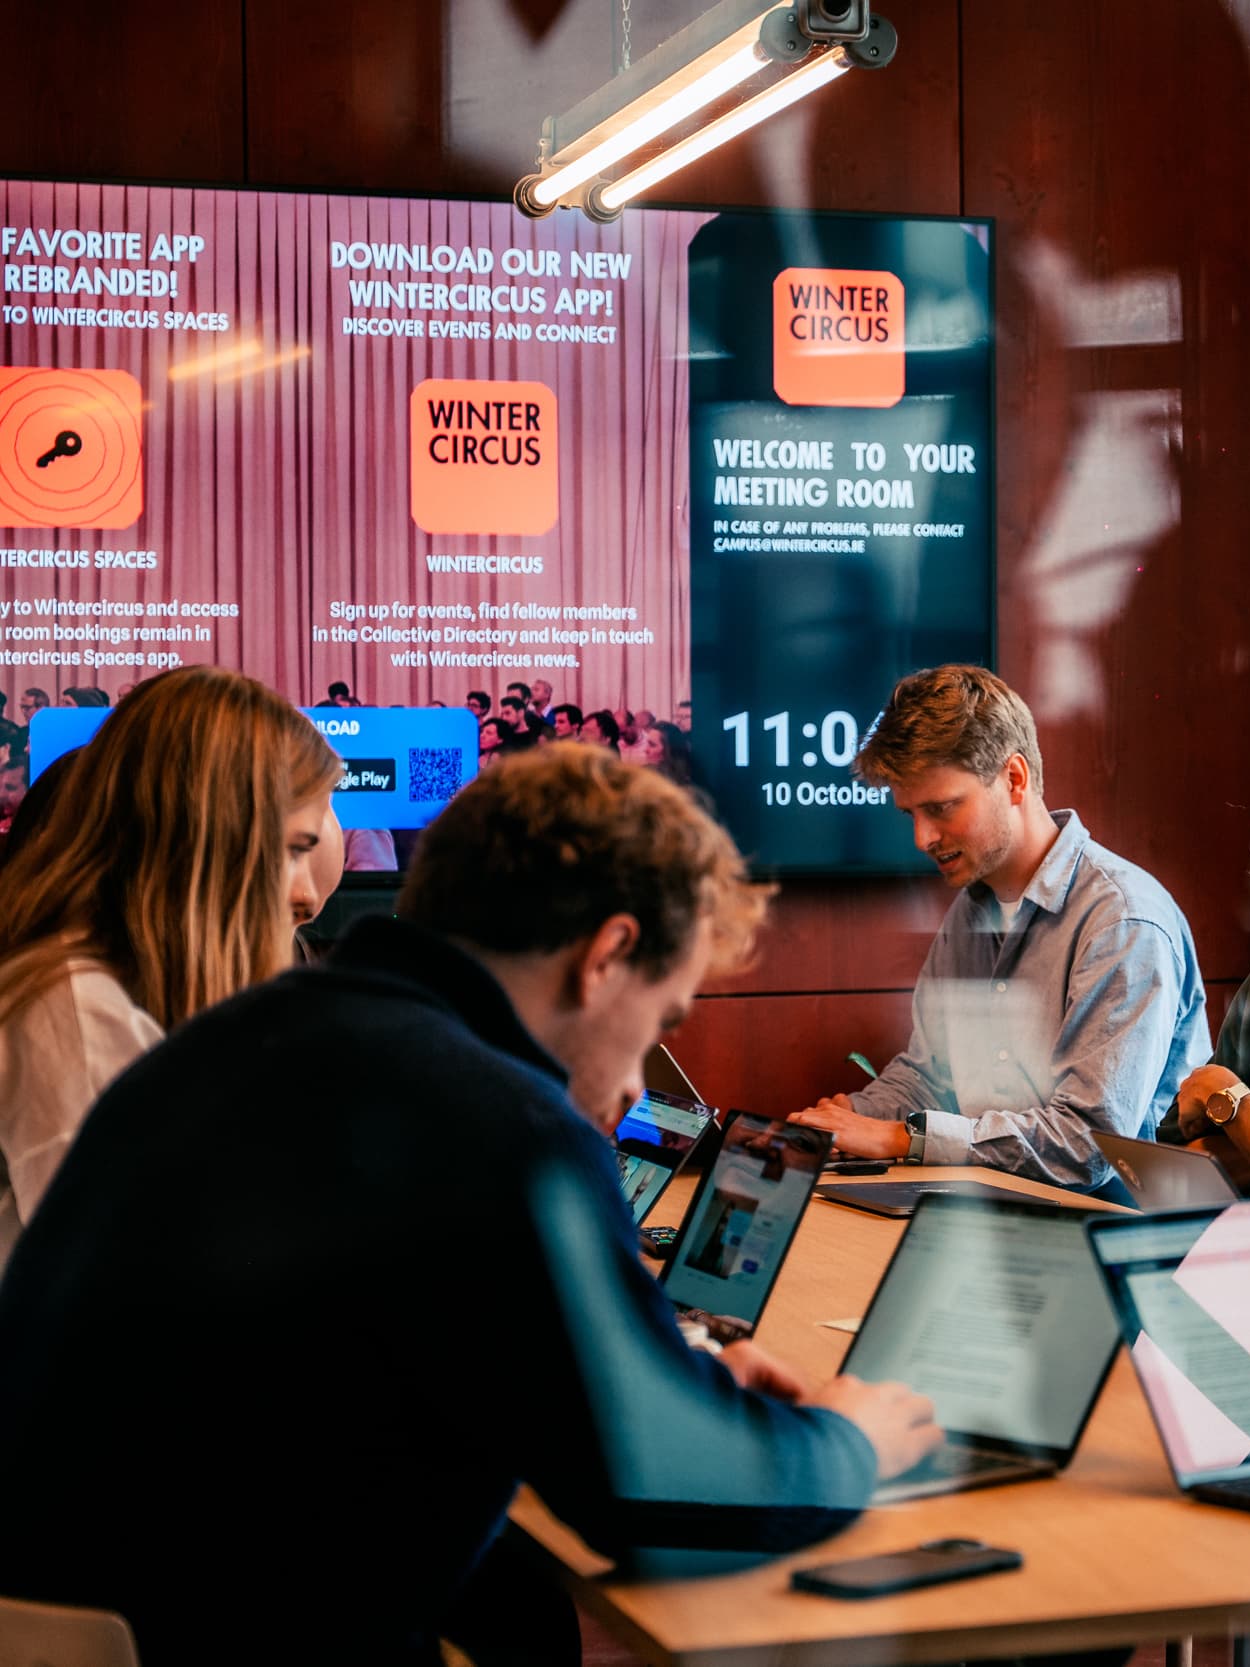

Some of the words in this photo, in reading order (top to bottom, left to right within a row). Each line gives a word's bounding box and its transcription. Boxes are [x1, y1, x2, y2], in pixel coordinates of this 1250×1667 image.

[1, 227, 141, 261] FAVORITE
[150, 234, 204, 262] APP
[331, 241, 494, 274] DOWNLOAD
[501, 248, 561, 277] OUR
[570, 251, 632, 280] NEW
[4, 264, 178, 299] REBRANDED!
[349, 280, 546, 314] WINTERCIRCUS
[553, 287, 613, 317] APP!
[790, 283, 889, 313] WINTER
[3, 305, 28, 324] TO
[32, 306, 159, 329] WINTERCIRCUS
[164, 311, 229, 332] SPACES
[342, 317, 424, 338] DISCOVER
[428, 320, 491, 340] EVENTS
[494, 322, 532, 341] AND
[535, 324, 616, 344] CONNECT
[790, 314, 889, 342] CIRCUS
[428, 400, 541, 431] WINTER
[429, 434, 541, 466] CIRCUS
[713, 439, 834, 470] WELCOME
[851, 442, 886, 472] TO
[903, 443, 976, 474] YOUR
[714, 476, 829, 507] MEETING
[836, 478, 914, 509] ROOM
[713, 520, 729, 534] IN
[730, 520, 760, 535] CASE
[763, 521, 780, 535] OF
[783, 521, 808, 536] ANY
[810, 521, 870, 537] PROBLEMS,
[873, 523, 910, 537] PLEASE
[913, 523, 965, 538] CONTACT
[94, 550, 157, 569] SPACES
[426, 554, 544, 574] WINTERCIRCUS
[14, 599, 32, 616] to
[34, 598, 145, 617] Wintercircus
[147, 599, 178, 617] and
[181, 602, 239, 618] access
[330, 601, 367, 621] Sign
[369, 605, 388, 622] up
[391, 602, 415, 619] for
[417, 603, 476, 623] events,
[478, 602, 509, 620] find
[512, 602, 560, 621] fellow
[563, 602, 637, 621] members
[5, 626, 49, 641] room
[54, 623, 130, 645] bookings
[133, 624, 192, 642] remain
[195, 624, 211, 642] in
[312, 625, 328, 642] in
[331, 625, 357, 643] the
[360, 625, 441, 643] Collective
[443, 626, 517, 647] Directory
[519, 627, 549, 644] and
[551, 627, 589, 647] keep
[592, 627, 606, 644] in
[609, 627, 654, 645] touch
[83, 649, 145, 668] Spaces
[147, 652, 184, 670] app.
[390, 650, 427, 667] with
[429, 651, 532, 668] Wintercircus
[533, 654, 580, 669] news.
[723, 710, 886, 767] 11:0
[361, 771, 390, 789] Play
[761, 782, 792, 806] 10
[796, 781, 891, 806] October
